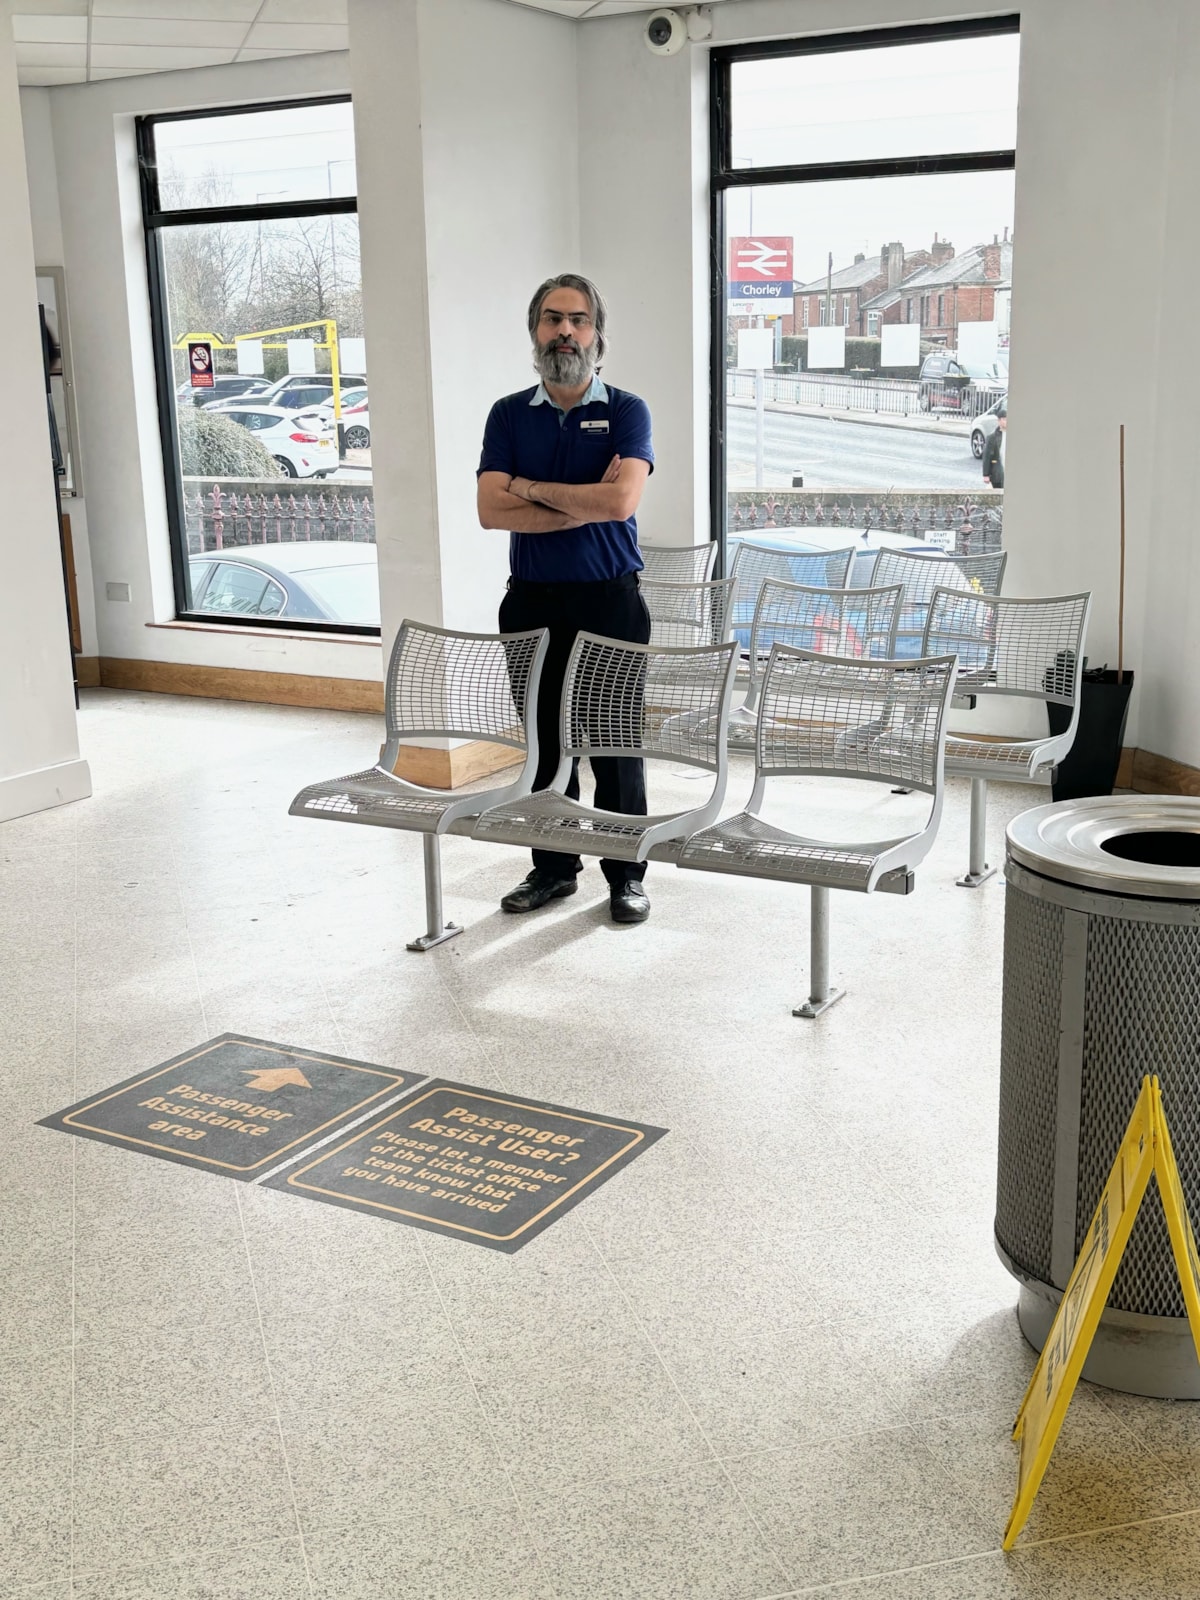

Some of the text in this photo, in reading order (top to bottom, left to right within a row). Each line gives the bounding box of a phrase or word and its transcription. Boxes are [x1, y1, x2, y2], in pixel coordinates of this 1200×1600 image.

[742, 284, 782, 296] Chorley
[137, 1096, 270, 1137] Assistance
[166, 1084, 294, 1122] Passenger
[147, 1119, 207, 1141] area
[409, 1118, 581, 1166] Assist User?
[442, 1106, 585, 1148] Passenger
[363, 1156, 518, 1201] team know that
[370, 1145, 542, 1193] of the ticket office
[375, 1131, 568, 1185] Please let a member
[341, 1166, 508, 1214] you have arrived
